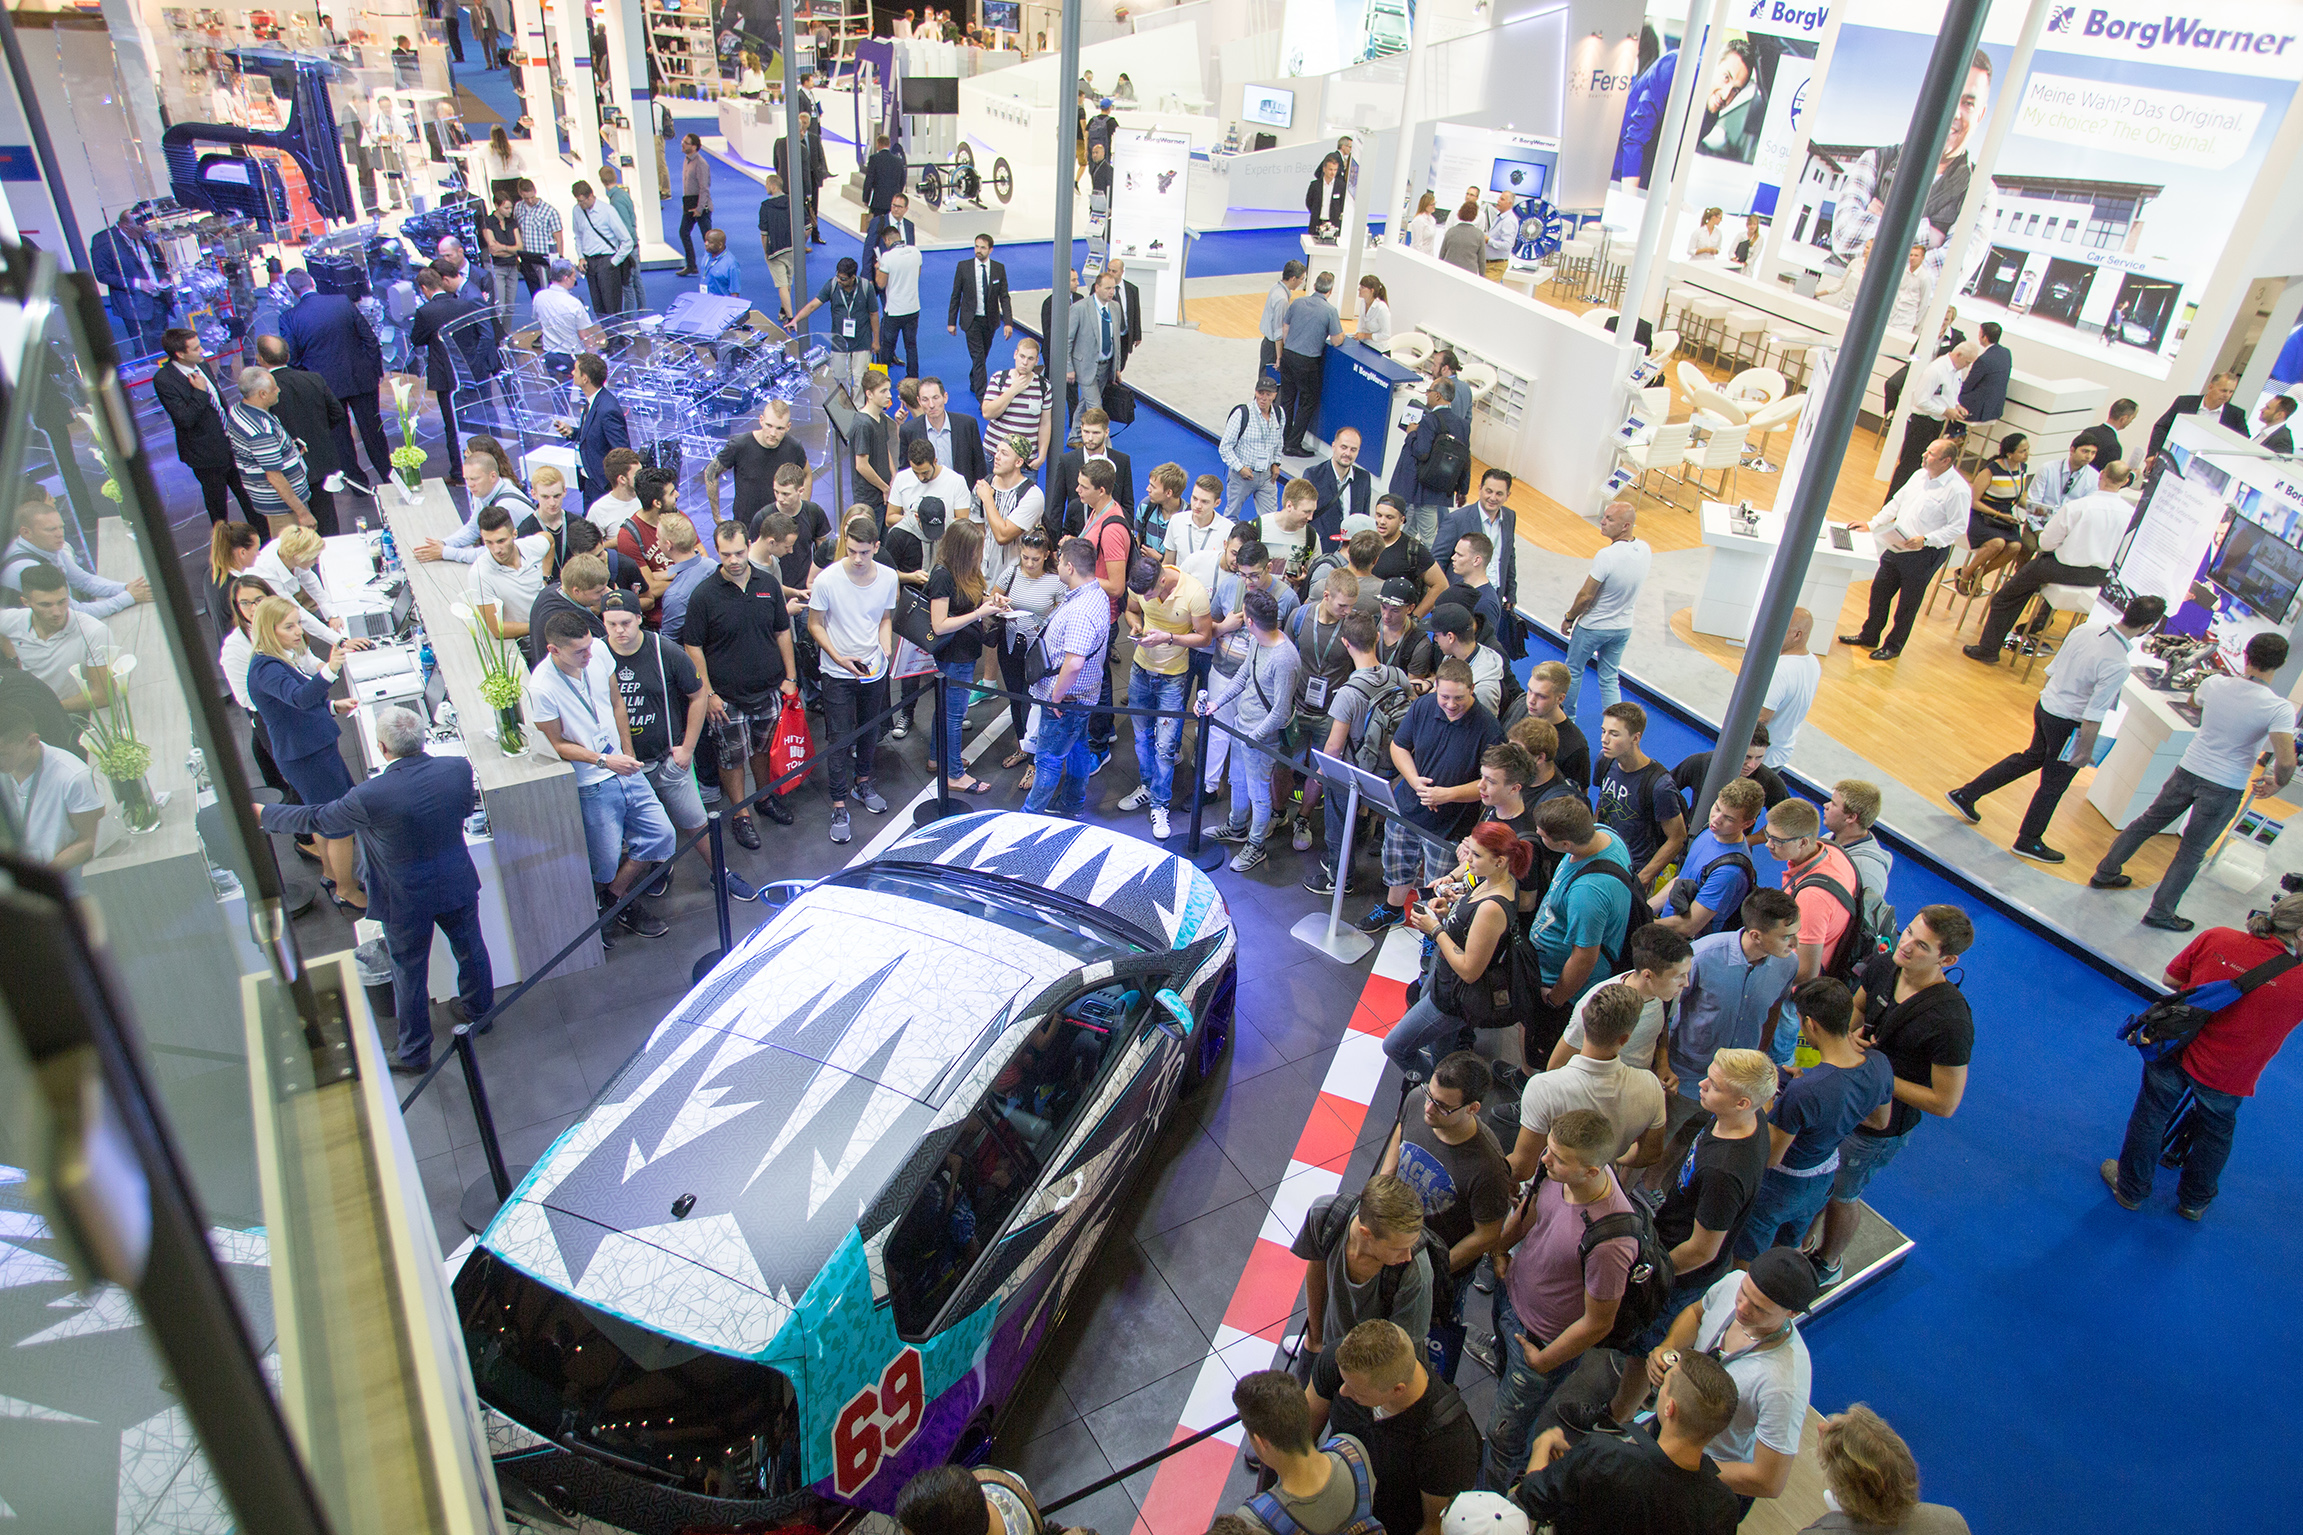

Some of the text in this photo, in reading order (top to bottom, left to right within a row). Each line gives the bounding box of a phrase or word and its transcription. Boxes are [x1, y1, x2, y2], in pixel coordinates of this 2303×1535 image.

[2083, 9, 2297, 55] BorgWarner
[1590, 69, 1632, 91] Fers
[2031, 83, 2242, 131] Meine Wahl? Das Original.
[2022, 106, 2216, 154] My choice? The Original.
[1765, 140, 1778, 154] So
[1245, 163, 1281, 177] Experts
[1283, 163, 1292, 173] in
[2087, 251, 2146, 271] Car Service
[1359, 365, 1389, 389] BorgWarner
[618, 683, 641, 693] EEP
[1399, 1142, 1438, 1191] ACK
[831, 1344, 926, 1499] 69
